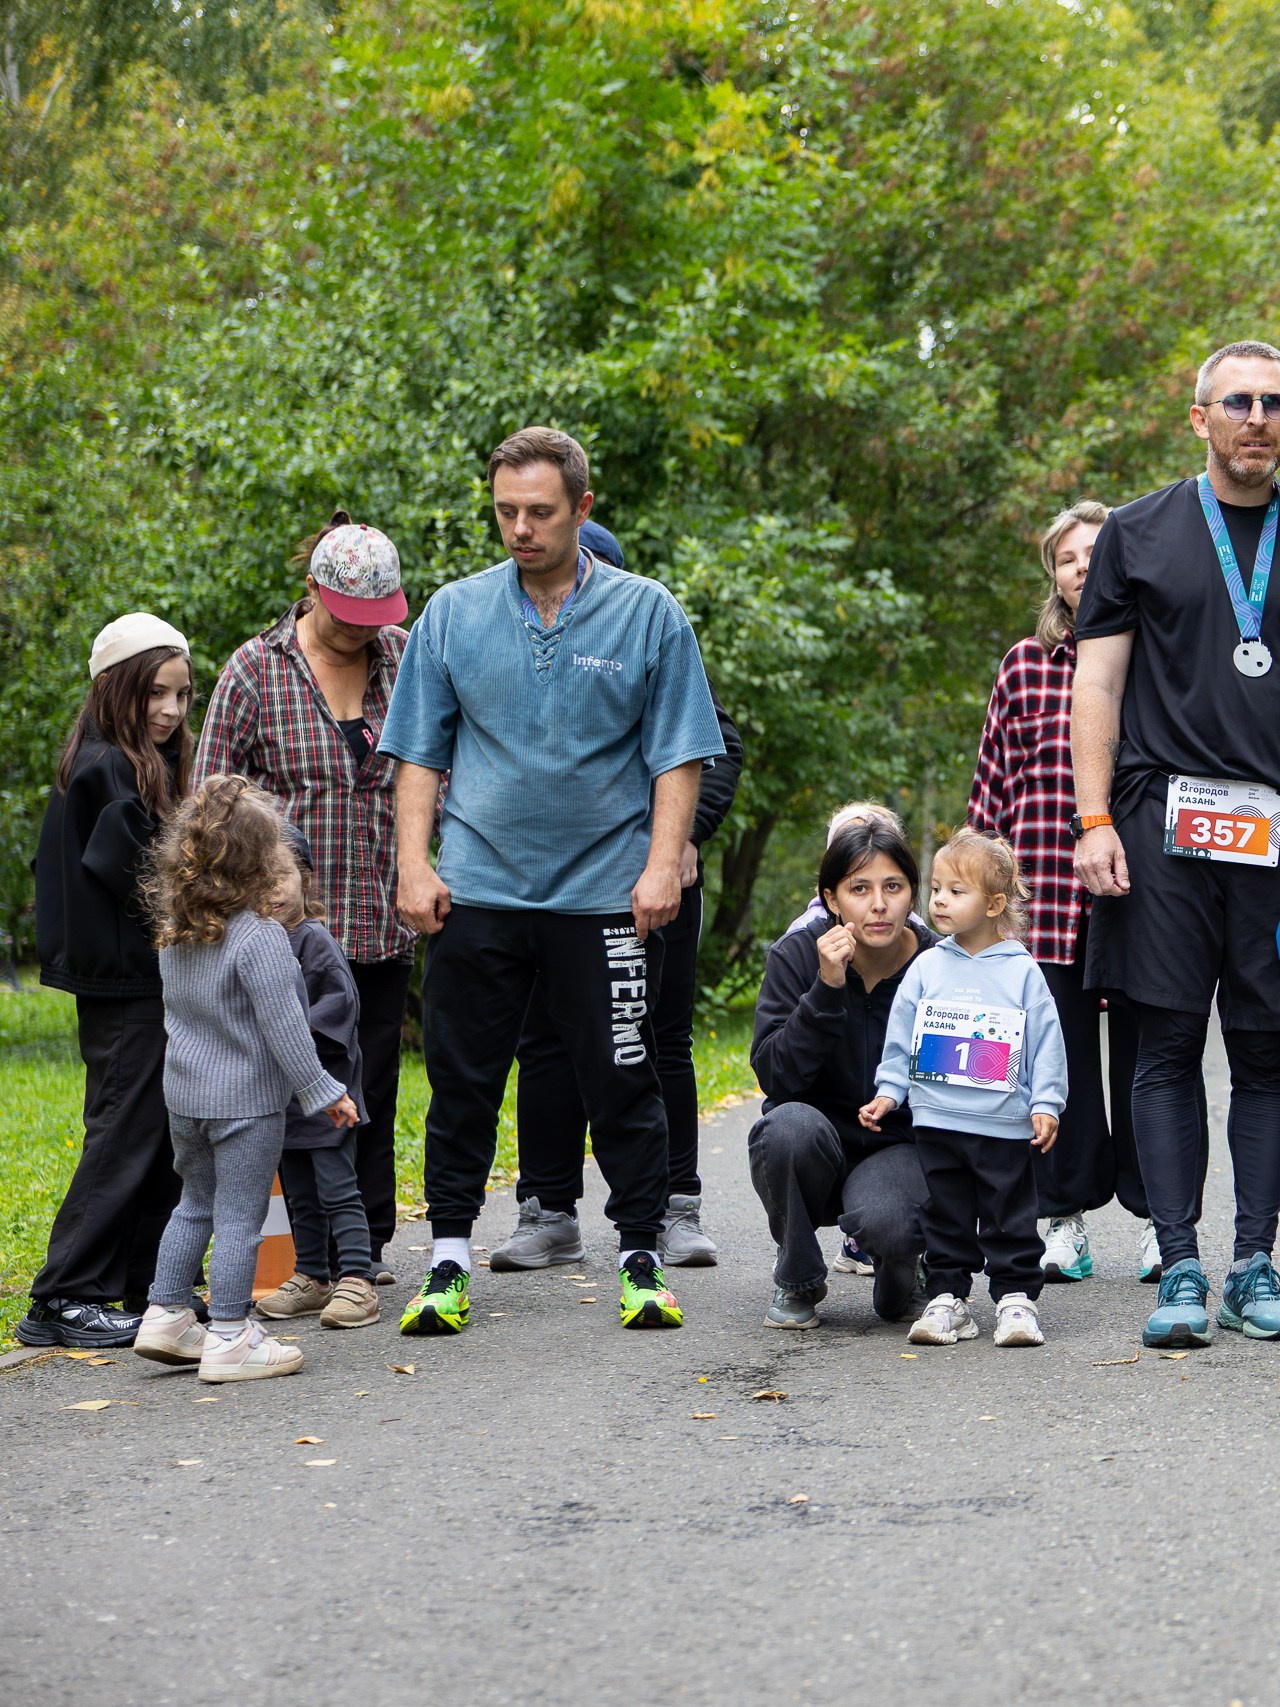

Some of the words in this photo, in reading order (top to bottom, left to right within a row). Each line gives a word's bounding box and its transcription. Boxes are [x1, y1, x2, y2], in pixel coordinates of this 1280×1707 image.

[573, 653, 623, 671] Inferno
[1178, 796, 1216, 806] КАЗАНЬ
[1189, 816, 1256, 848] 357
[603, 927, 649, 1067] INFERNO
[923, 1021, 957, 1031] КАЗАНЬ
[955, 1042, 971, 1071] 1
